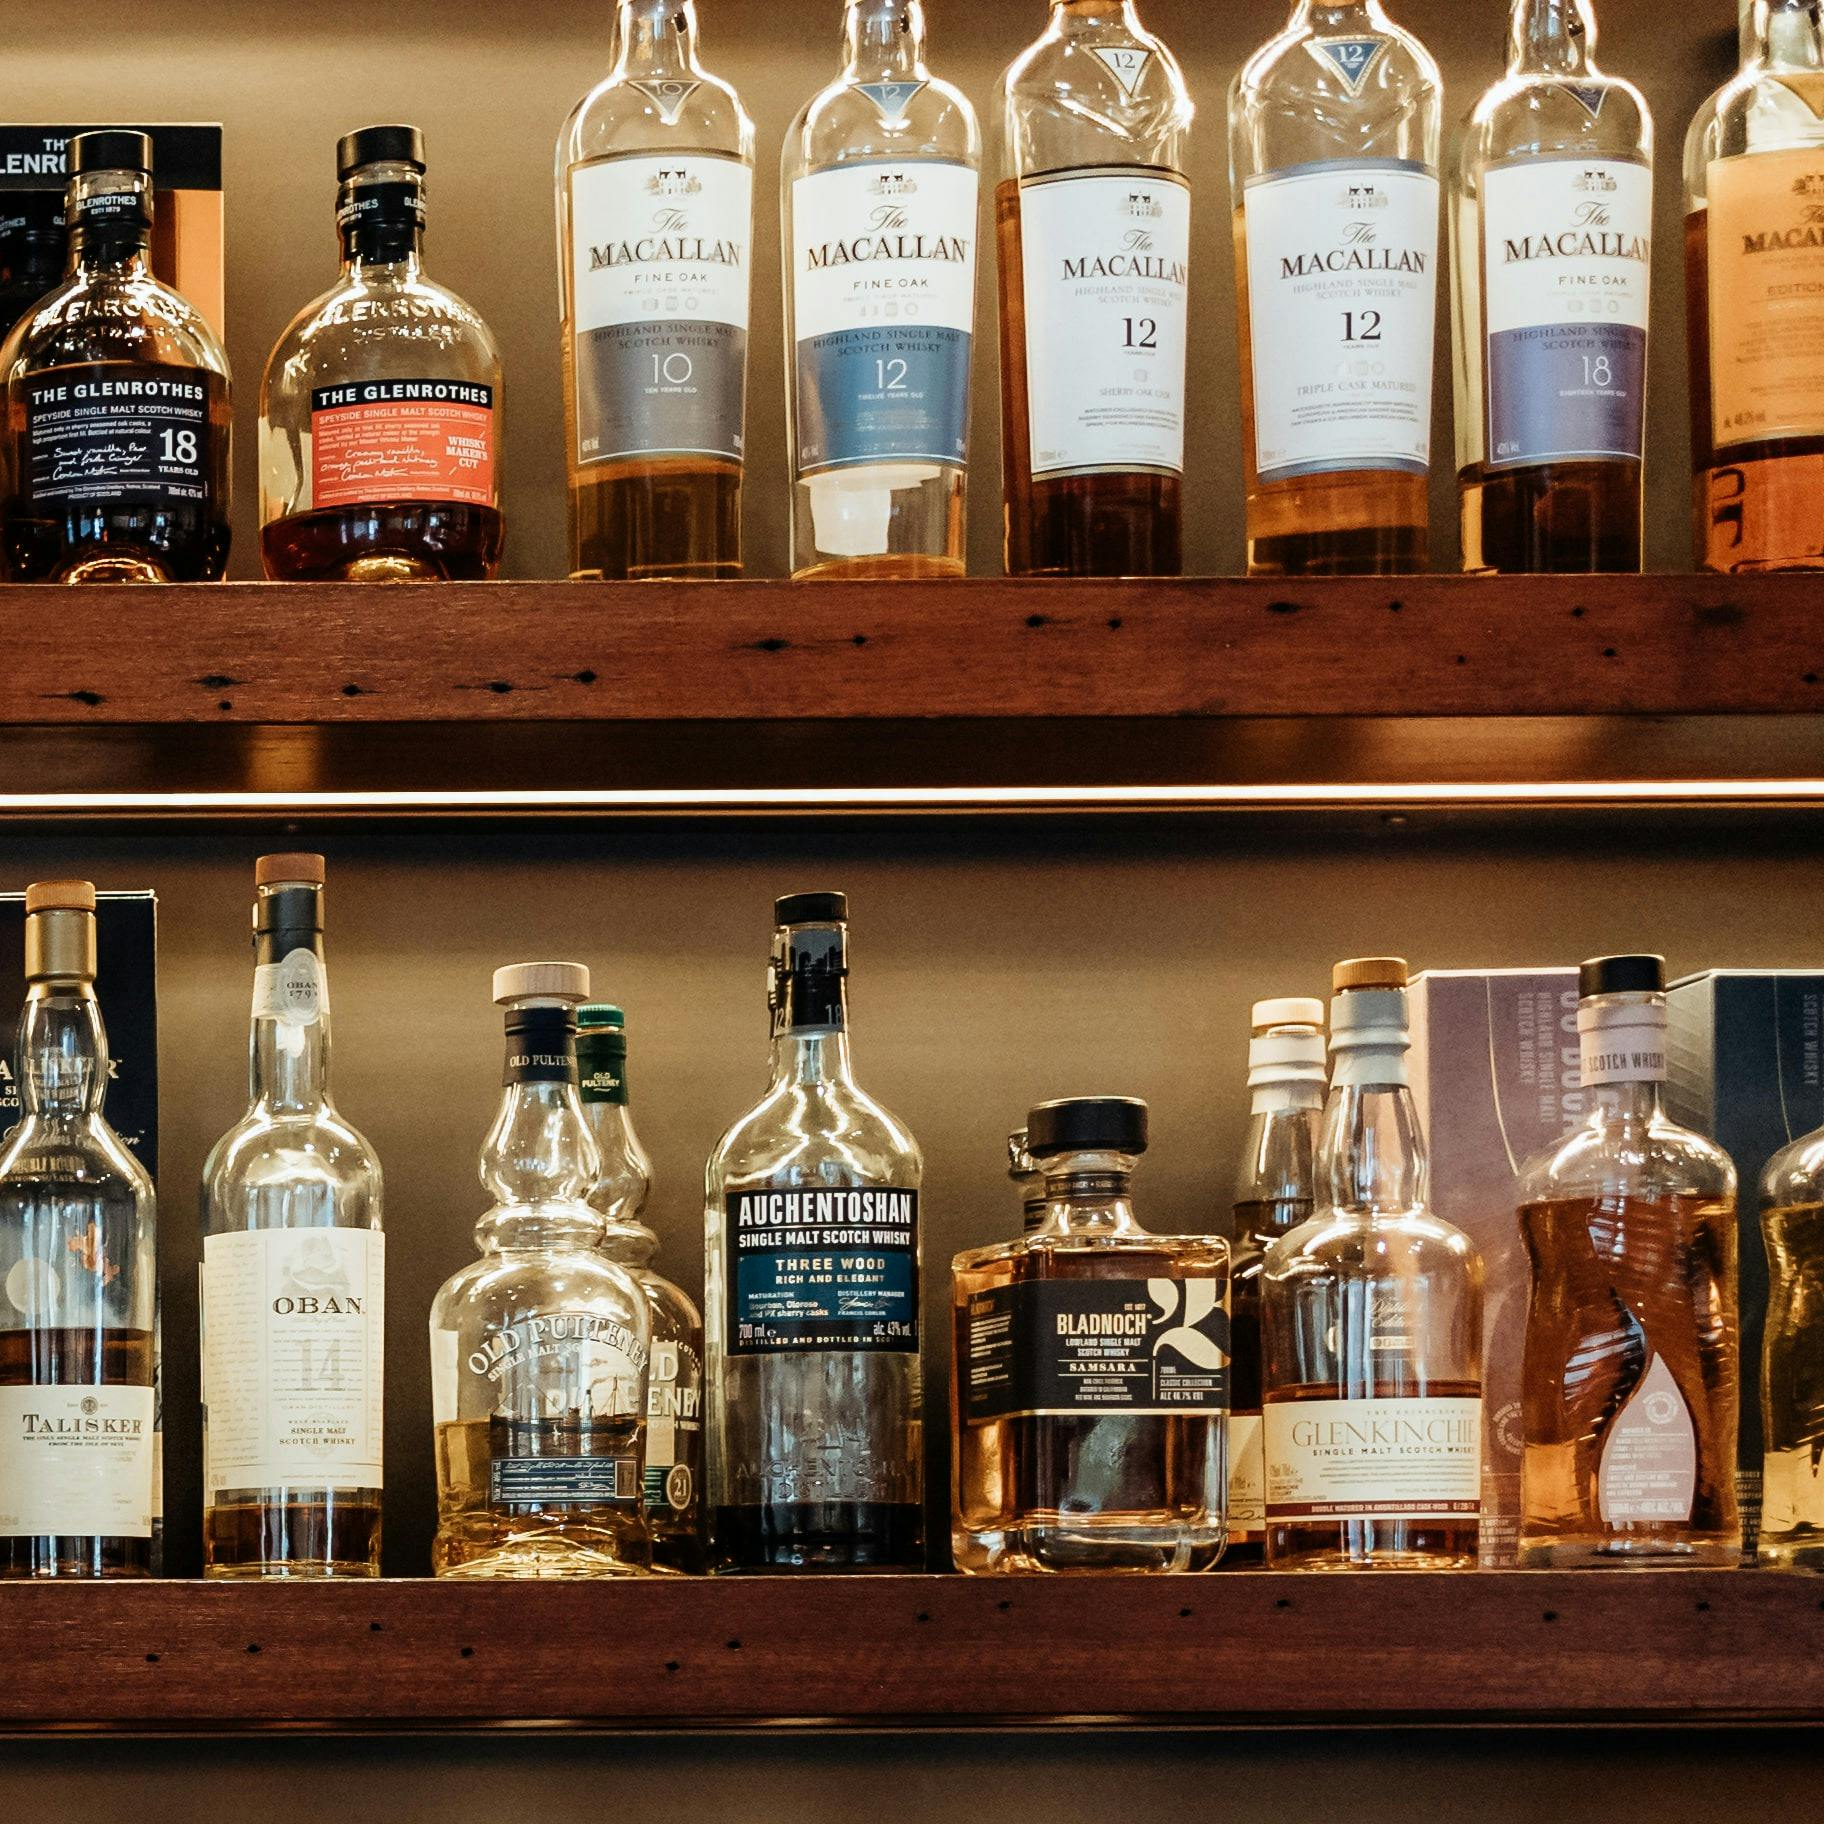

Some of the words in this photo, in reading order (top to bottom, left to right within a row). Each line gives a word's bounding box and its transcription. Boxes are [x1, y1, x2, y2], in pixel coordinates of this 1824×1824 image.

[589, 237, 741, 271] MACALLAN
[807, 236, 968, 271] MACALLAN
[1504, 237, 1648, 266] MACALLAN
[1062, 255, 1186, 282] MACALLAN
[1279, 251, 1428, 280] MACALLAN
[634, 272, 673, 282] FINE
[679, 272, 708, 282] OAK
[876, 358, 907, 389] 12
[32, 388, 68, 403] THE
[73, 382, 203, 400] GLENROTHES
[320, 391, 356, 407] THE
[361, 385, 487, 404] GLENROTHES
[159, 429, 197, 463] 18
[448, 436, 486, 450] WHISKY
[459, 459, 478, 469] CUT
[738, 1192, 911, 1227] AUCHENTOSHAN
[738, 1232, 783, 1248] SINGLE
[786, 1231, 819, 1245] MALT
[823, 1230, 868, 1245] SCOTCH
[872, 1230, 910, 1246] WHISKY
[776, 1258, 833, 1272] THREE
[841, 1257, 885, 1271] WOOD
[273, 1297, 362, 1315] OBAN
[1056, 1313, 1147, 1335] BLADNOCH
[1068, 1363, 1136, 1372] SAMSARA
[22, 1413, 141, 1435] TALISKER
[1292, 1419, 1475, 1450] GLENKINCHIE
